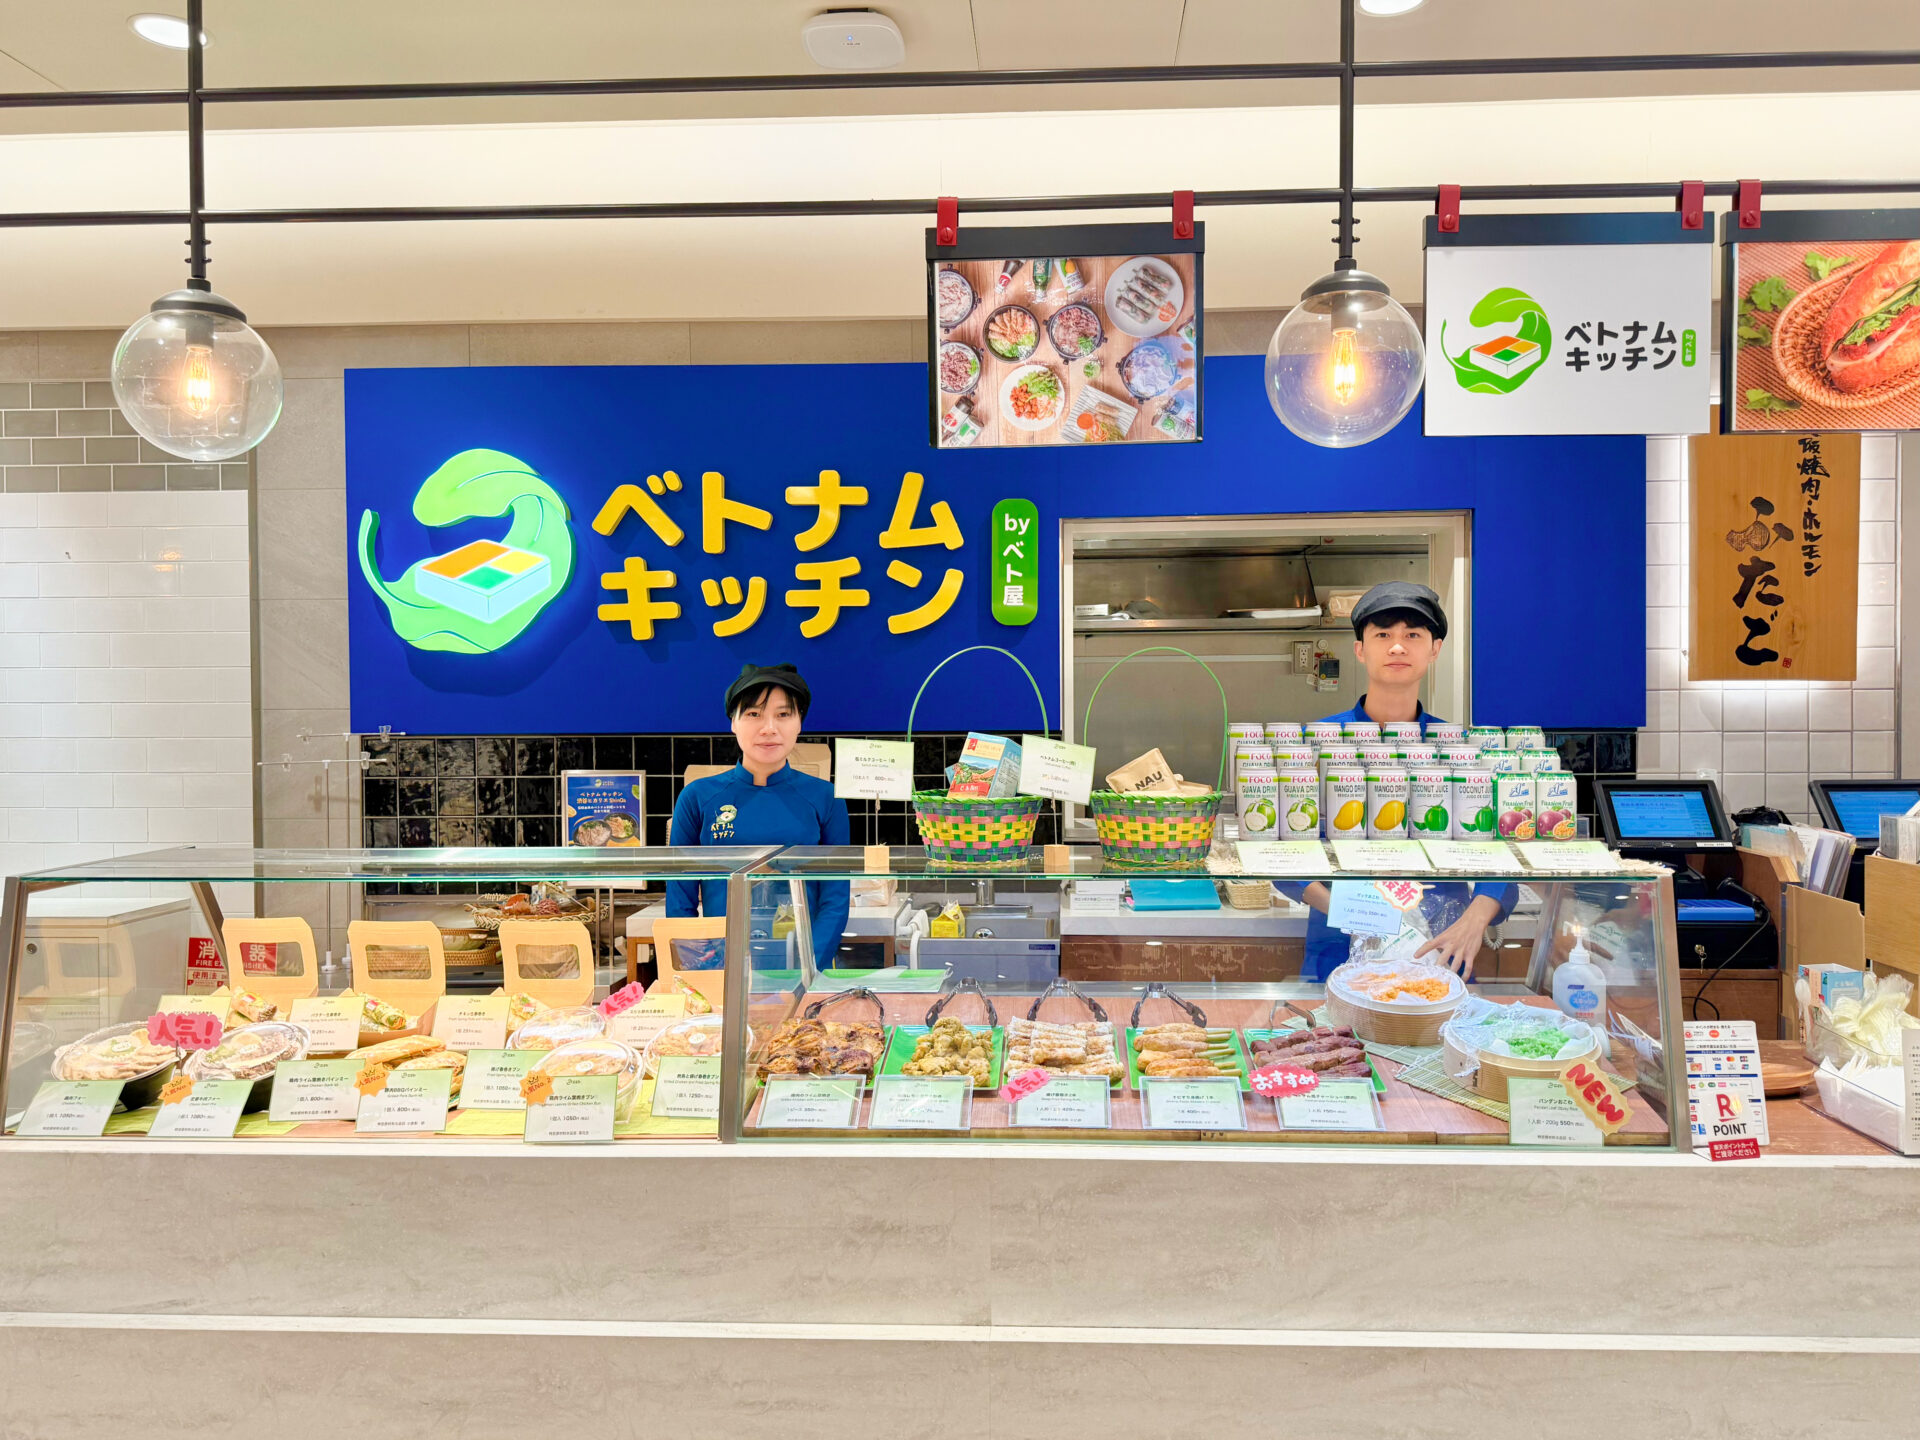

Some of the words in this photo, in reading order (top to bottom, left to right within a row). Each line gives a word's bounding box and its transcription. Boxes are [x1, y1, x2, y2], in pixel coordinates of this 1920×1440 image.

[1565, 320, 1677, 346] ベトナム
[1565, 347, 1677, 372] キッチン
[591, 469, 965, 554] ベトナム
[1796, 434, 1830, 578] 阪焼肉・ホルモン
[1004, 513, 1031, 535] by
[1003, 541, 1025, 606] ベト屋
[596, 556, 965, 641] キッチン
[1316, 730, 1338, 738] FOCO
[1355, 730, 1377, 738] FOCO
[1439, 731, 1461, 739] FOCO
[1333, 752, 1355, 760] FOCO
[1408, 752, 1431, 760] FOCO
[1451, 753, 1474, 761] FOCO
[1135, 771, 1163, 791] NAU
[1242, 785, 1261, 793] GUAVA
[1284, 785, 1304, 793] GUAVA
[1334, 785, 1353, 793] MANGO
[1374, 785, 1394, 793] MANGO
[1411, 785, 1434, 793] COCONUT
[1435, 785, 1449, 793] JUICE
[1459, 786, 1484, 794] COCONUT
[196, 959, 213, 967] FIRE
[605, 985, 639, 1015] 人気!
[155, 1015, 215, 1045] 人気!
[1008, 1070, 1044, 1099] 人気!
[1252, 1070, 1315, 1091] おすすめ
[1566, 1063, 1625, 1125] NEW
[1713, 1123, 1747, 1136] POINT
[1715, 1149, 1756, 1158] ご提示ください
